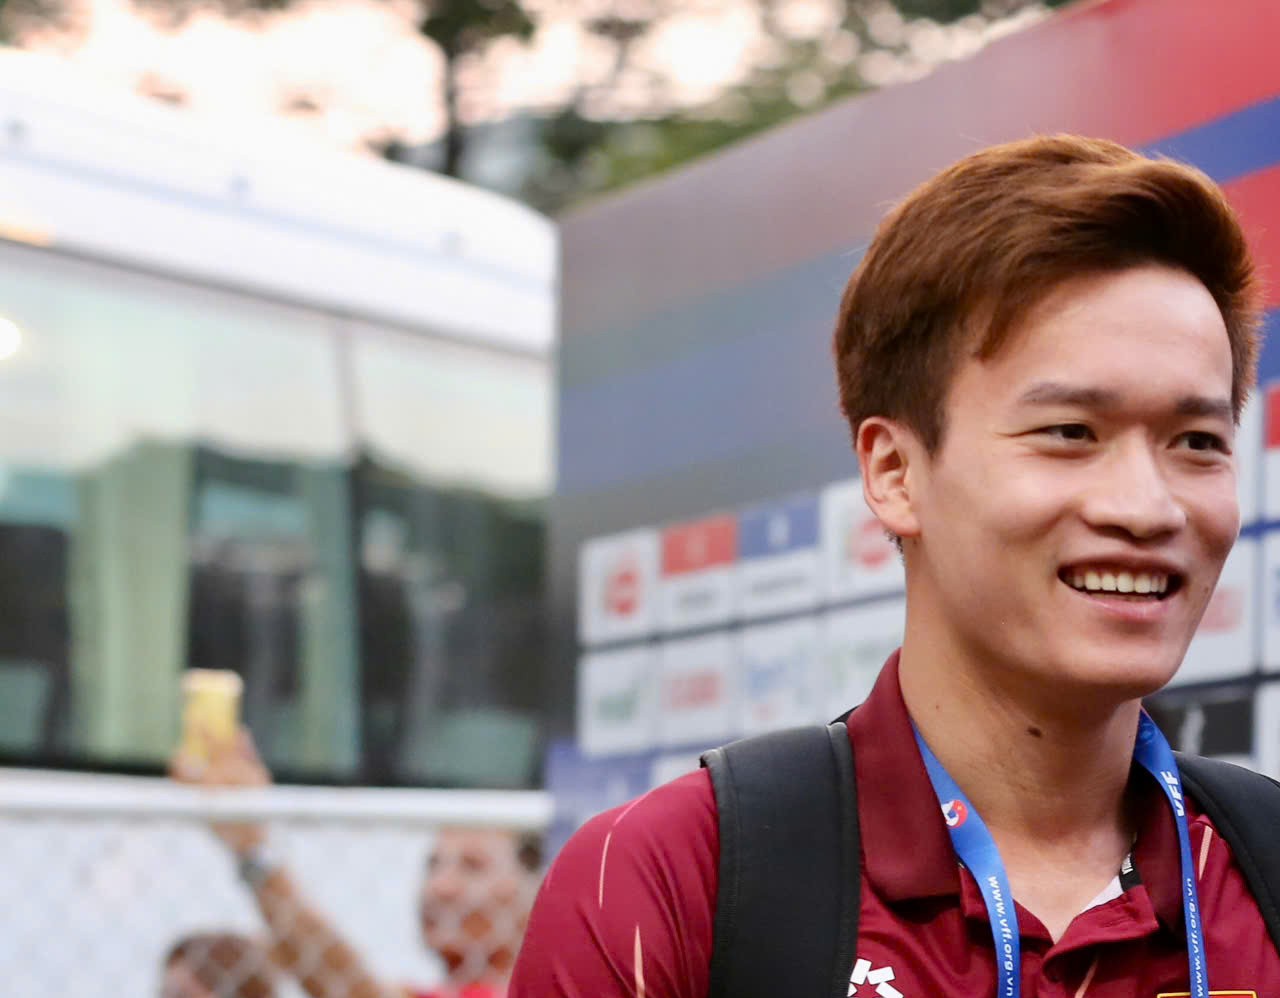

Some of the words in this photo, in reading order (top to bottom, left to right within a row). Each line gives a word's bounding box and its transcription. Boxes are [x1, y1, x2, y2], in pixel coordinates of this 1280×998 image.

[1160, 770, 1185, 818] VFF
[986, 874, 1015, 997] www.vff.org.vn
[1185, 877, 1205, 998] www.vff.org.vn
